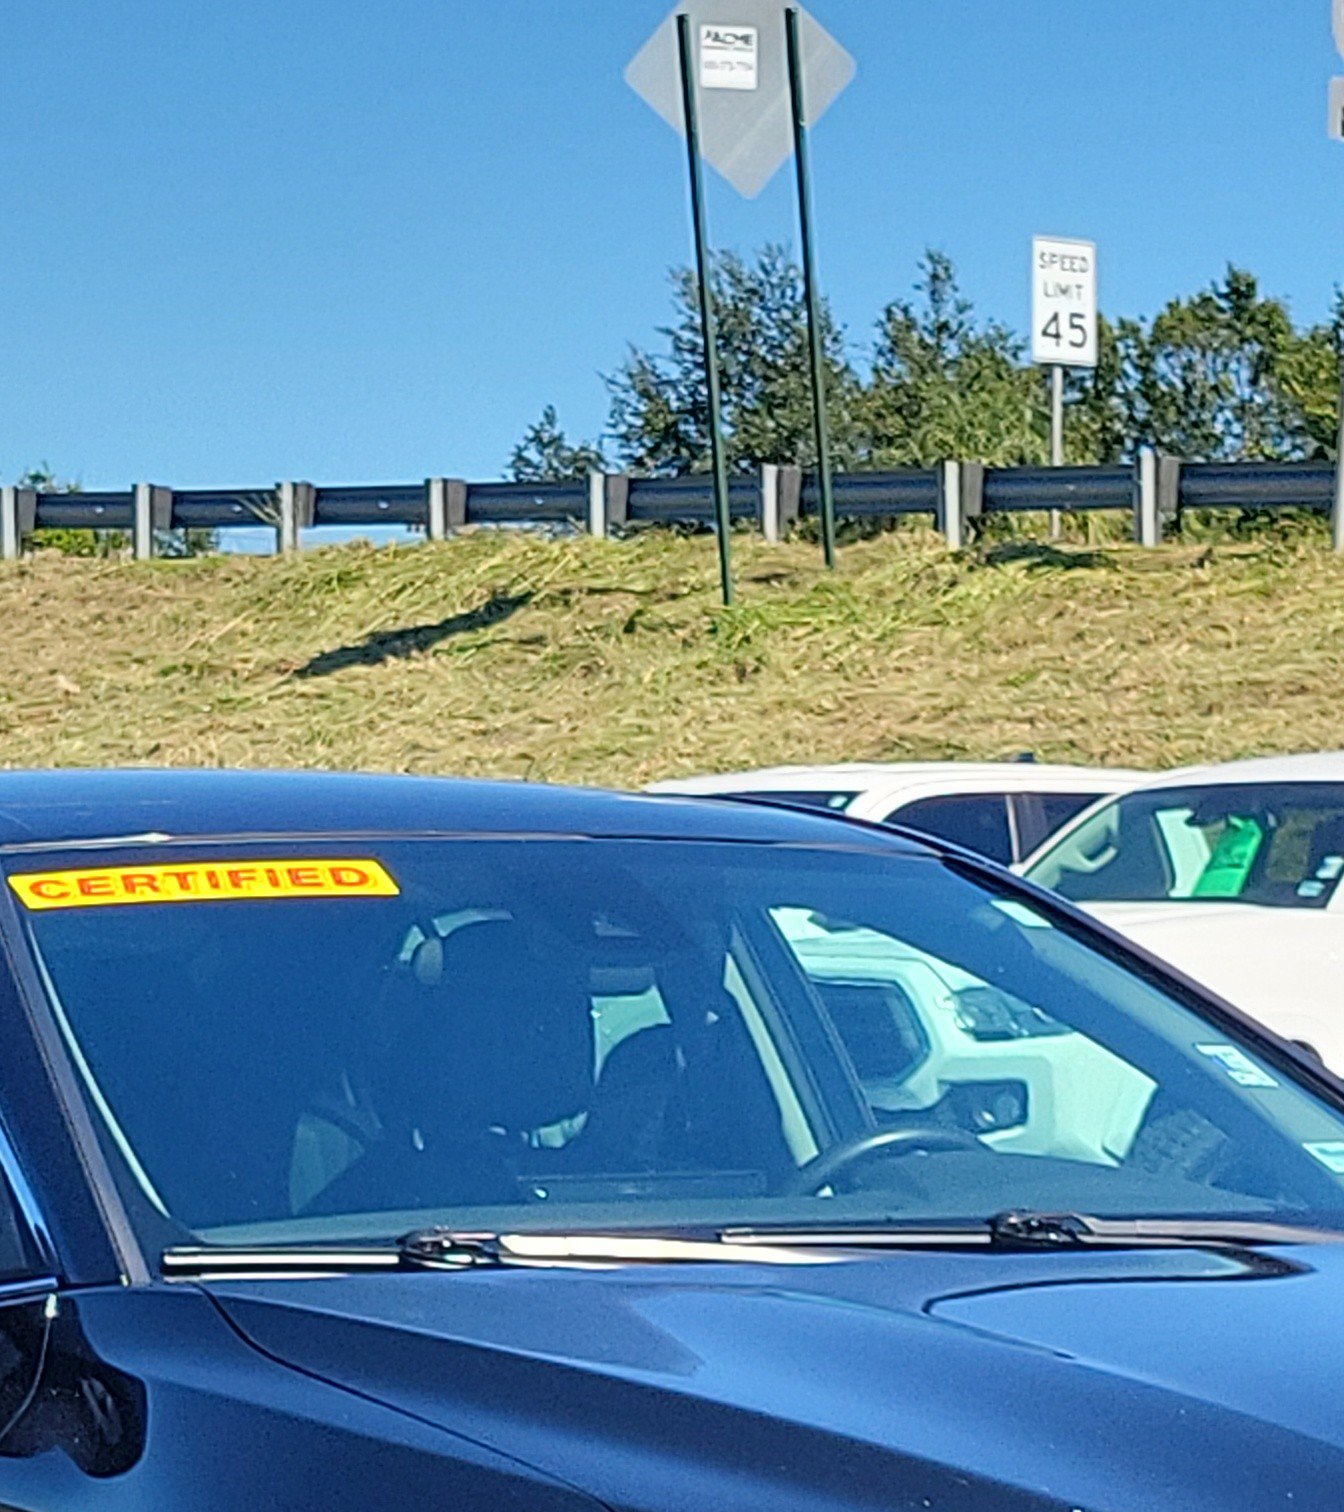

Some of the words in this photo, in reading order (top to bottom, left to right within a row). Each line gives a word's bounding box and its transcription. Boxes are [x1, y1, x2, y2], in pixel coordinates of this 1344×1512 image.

[1039, 252, 1089, 273] SPEED
[1043, 281, 1084, 300] LIMIT
[1041, 311, 1088, 348] 45
[28, 866, 371, 899] CERTIFIED
